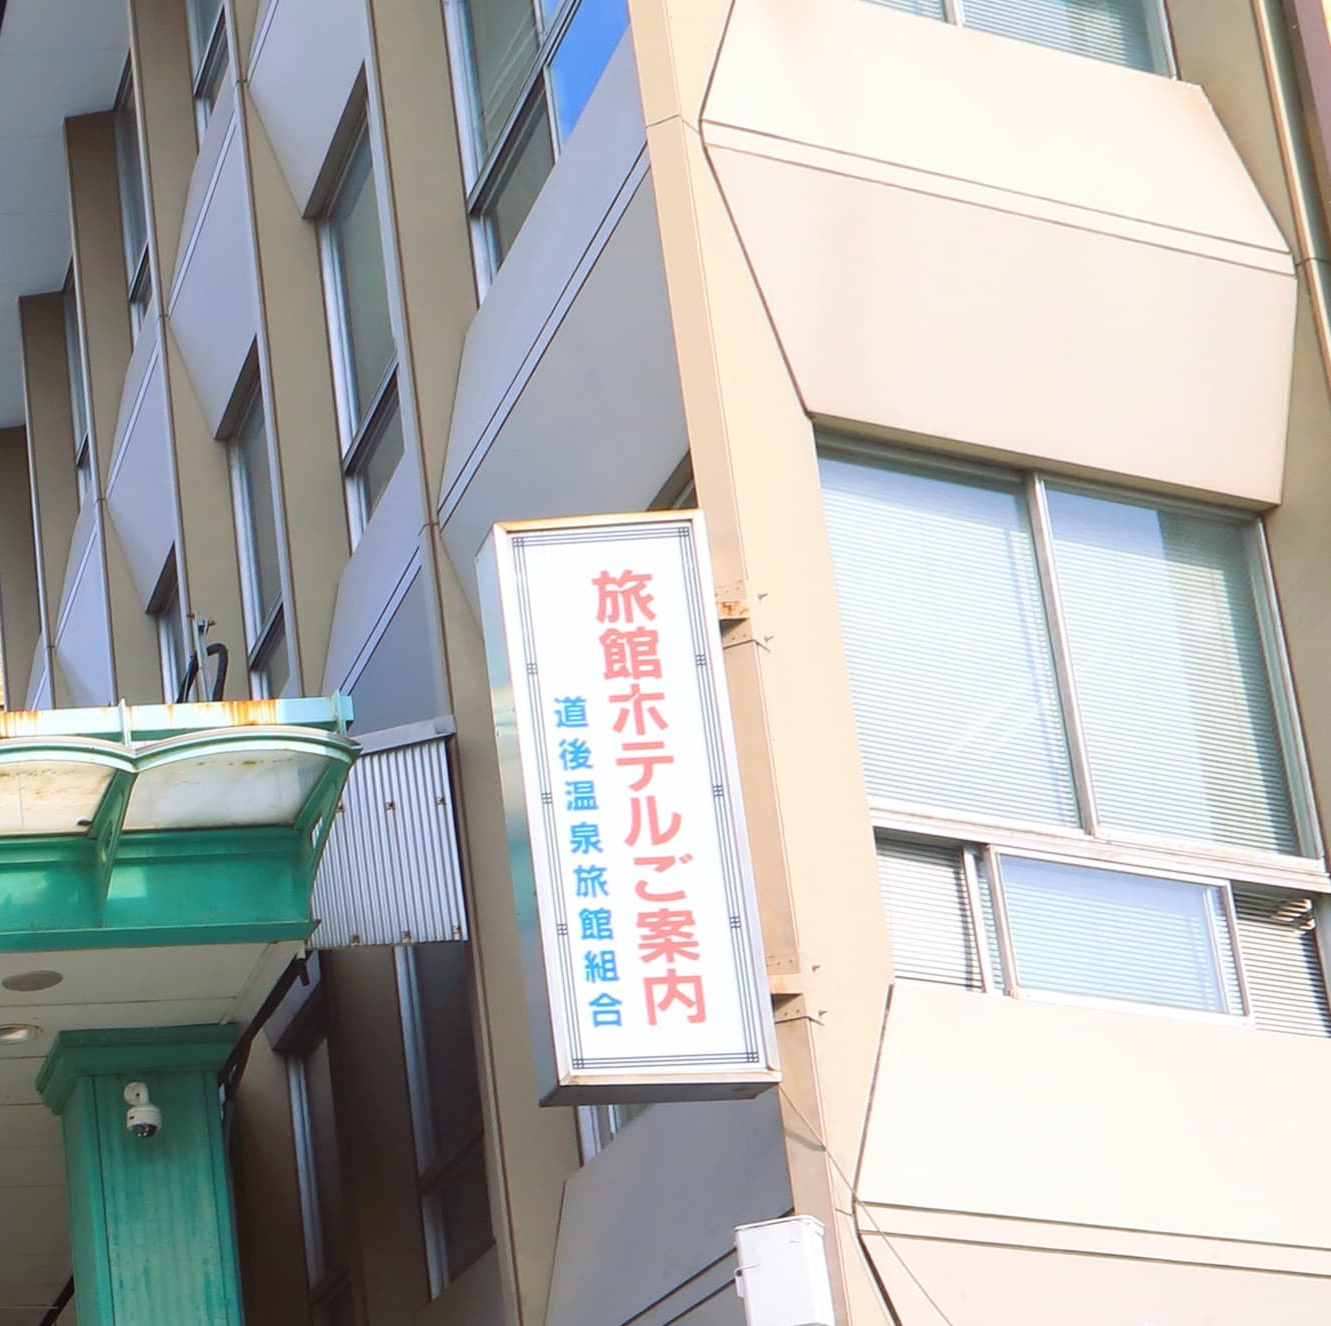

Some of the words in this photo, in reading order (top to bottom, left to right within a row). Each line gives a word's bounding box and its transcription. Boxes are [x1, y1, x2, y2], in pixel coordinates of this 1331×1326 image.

[553, 696, 624, 1029] 道後温泉旅館組合
[591, 569, 707, 1027] 旅館ホテルご案内
